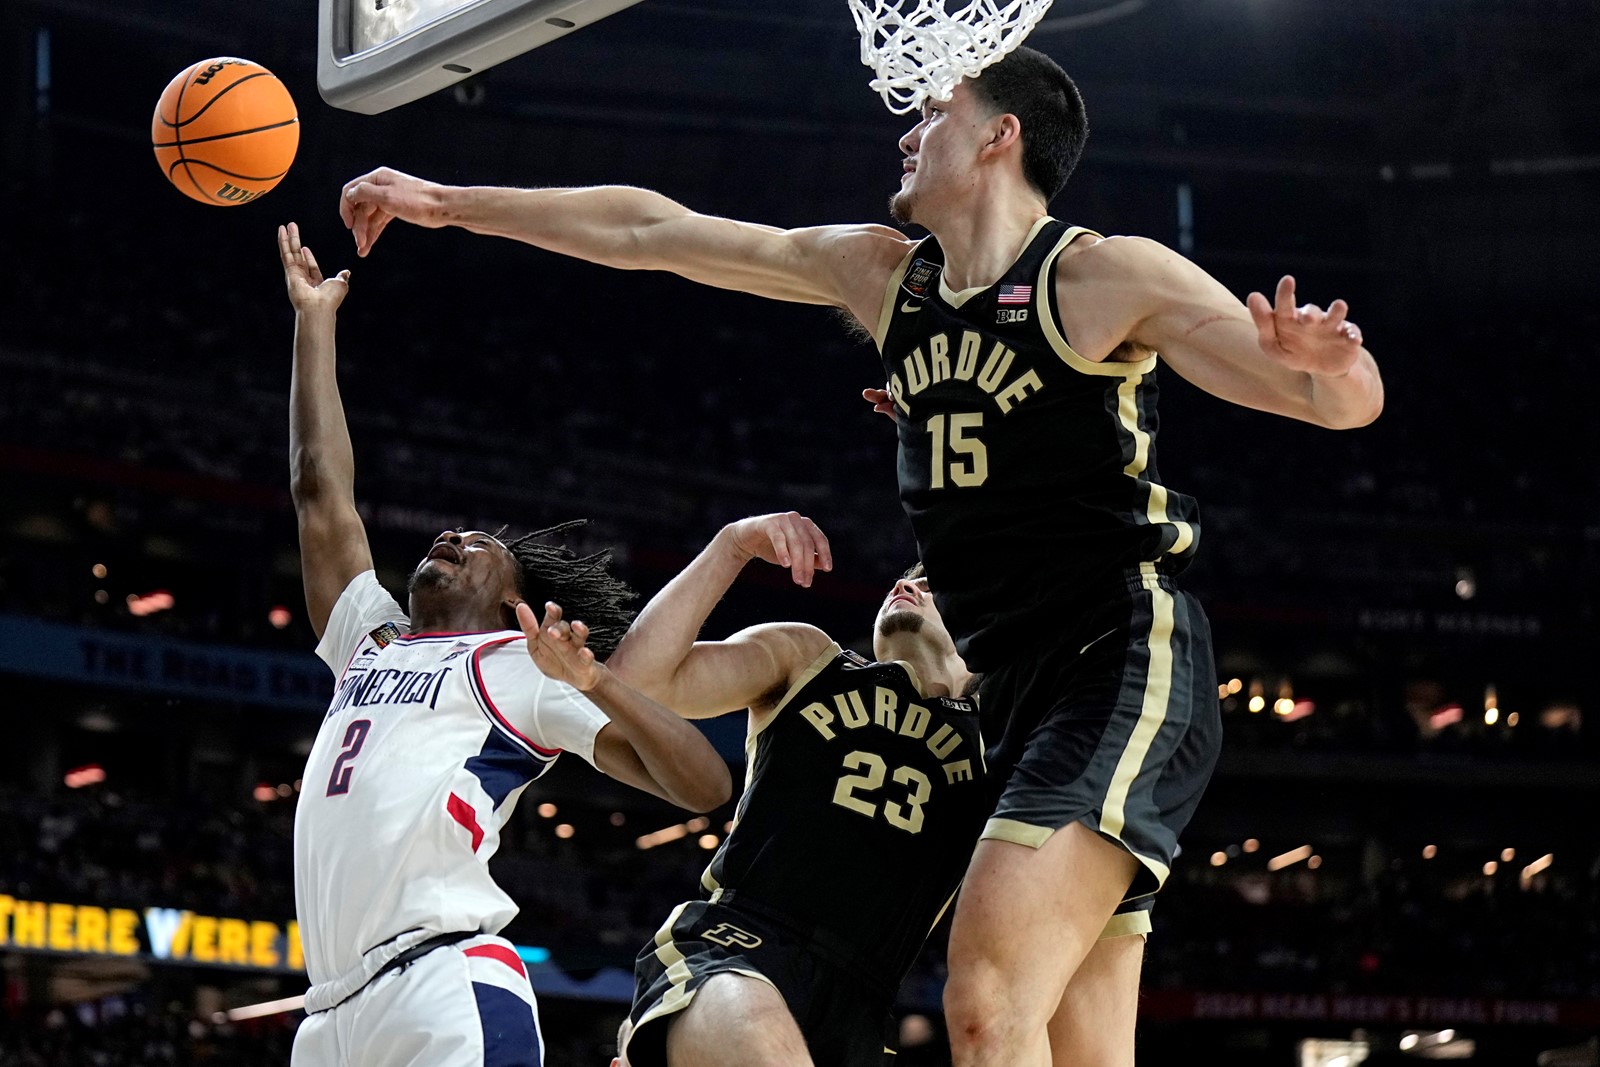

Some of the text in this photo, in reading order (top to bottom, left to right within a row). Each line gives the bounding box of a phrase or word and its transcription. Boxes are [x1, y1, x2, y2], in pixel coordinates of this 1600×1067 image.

[890, 330, 1044, 417] PURDUE
[926, 412, 989, 489] 15
[326, 719, 372, 797] 2
[799, 685, 973, 785] PURDUE
[832, 750, 932, 835] 23
[145, 906, 279, 967] WERE
